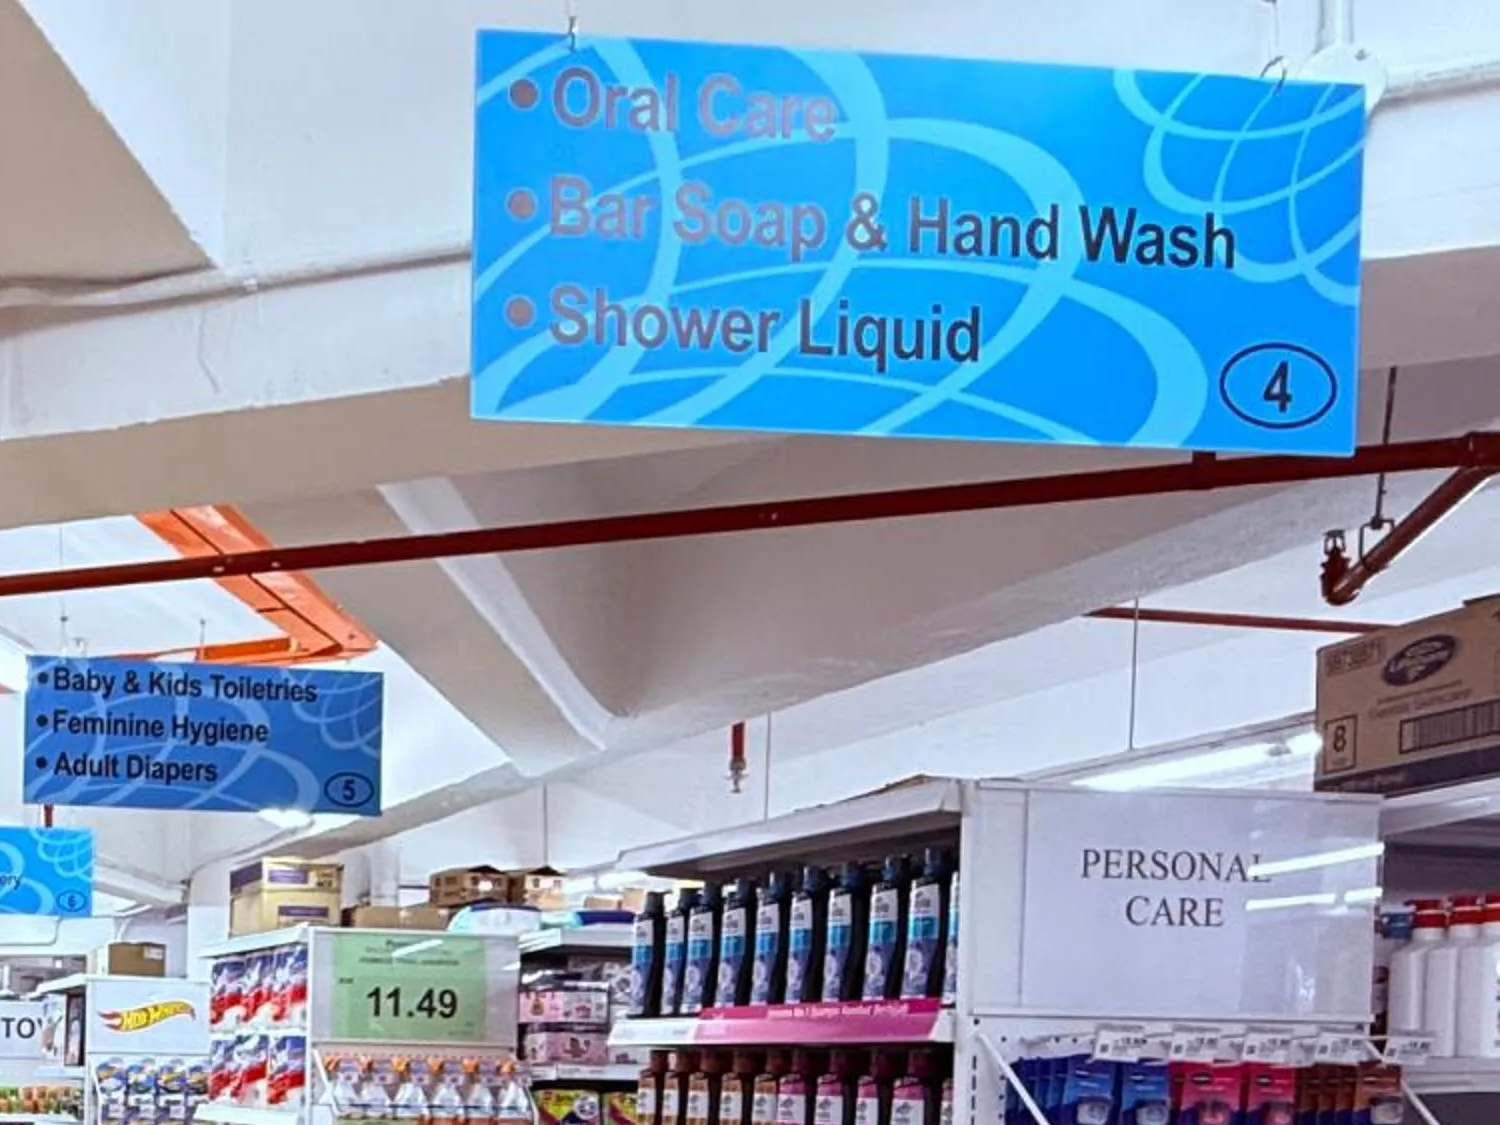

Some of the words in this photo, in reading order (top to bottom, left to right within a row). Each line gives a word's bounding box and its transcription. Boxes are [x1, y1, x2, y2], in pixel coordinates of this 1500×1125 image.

[553, 67, 677, 134] Oral
[699, 78, 838, 142] Care
[549, 177, 651, 240] Bar
[673, 184, 826, 264] Soap
[846, 192, 887, 252] &
[909, 196, 1061, 261] Hand
[1079, 206, 1236, 269] Wash
[549, 287, 780, 354] Shower
[798, 301, 982, 373] Liquid
[1263, 361, 1293, 413] 4
[53, 667, 116, 698] Baby
[122, 671, 140, 694] &
[149, 671, 202, 698] Kids
[210, 674, 318, 703] Toiletries
[53, 709, 164, 738] Feminine
[171, 716, 269, 745] Hygiene
[1332, 725, 1347, 752] 8
[53, 751, 119, 779] Adult
[126, 755, 218, 785] Diapers
[343, 779, 356, 800] 5
[1125, 895, 1225, 928] CARE
[367, 985, 458, 1020] 11.49
